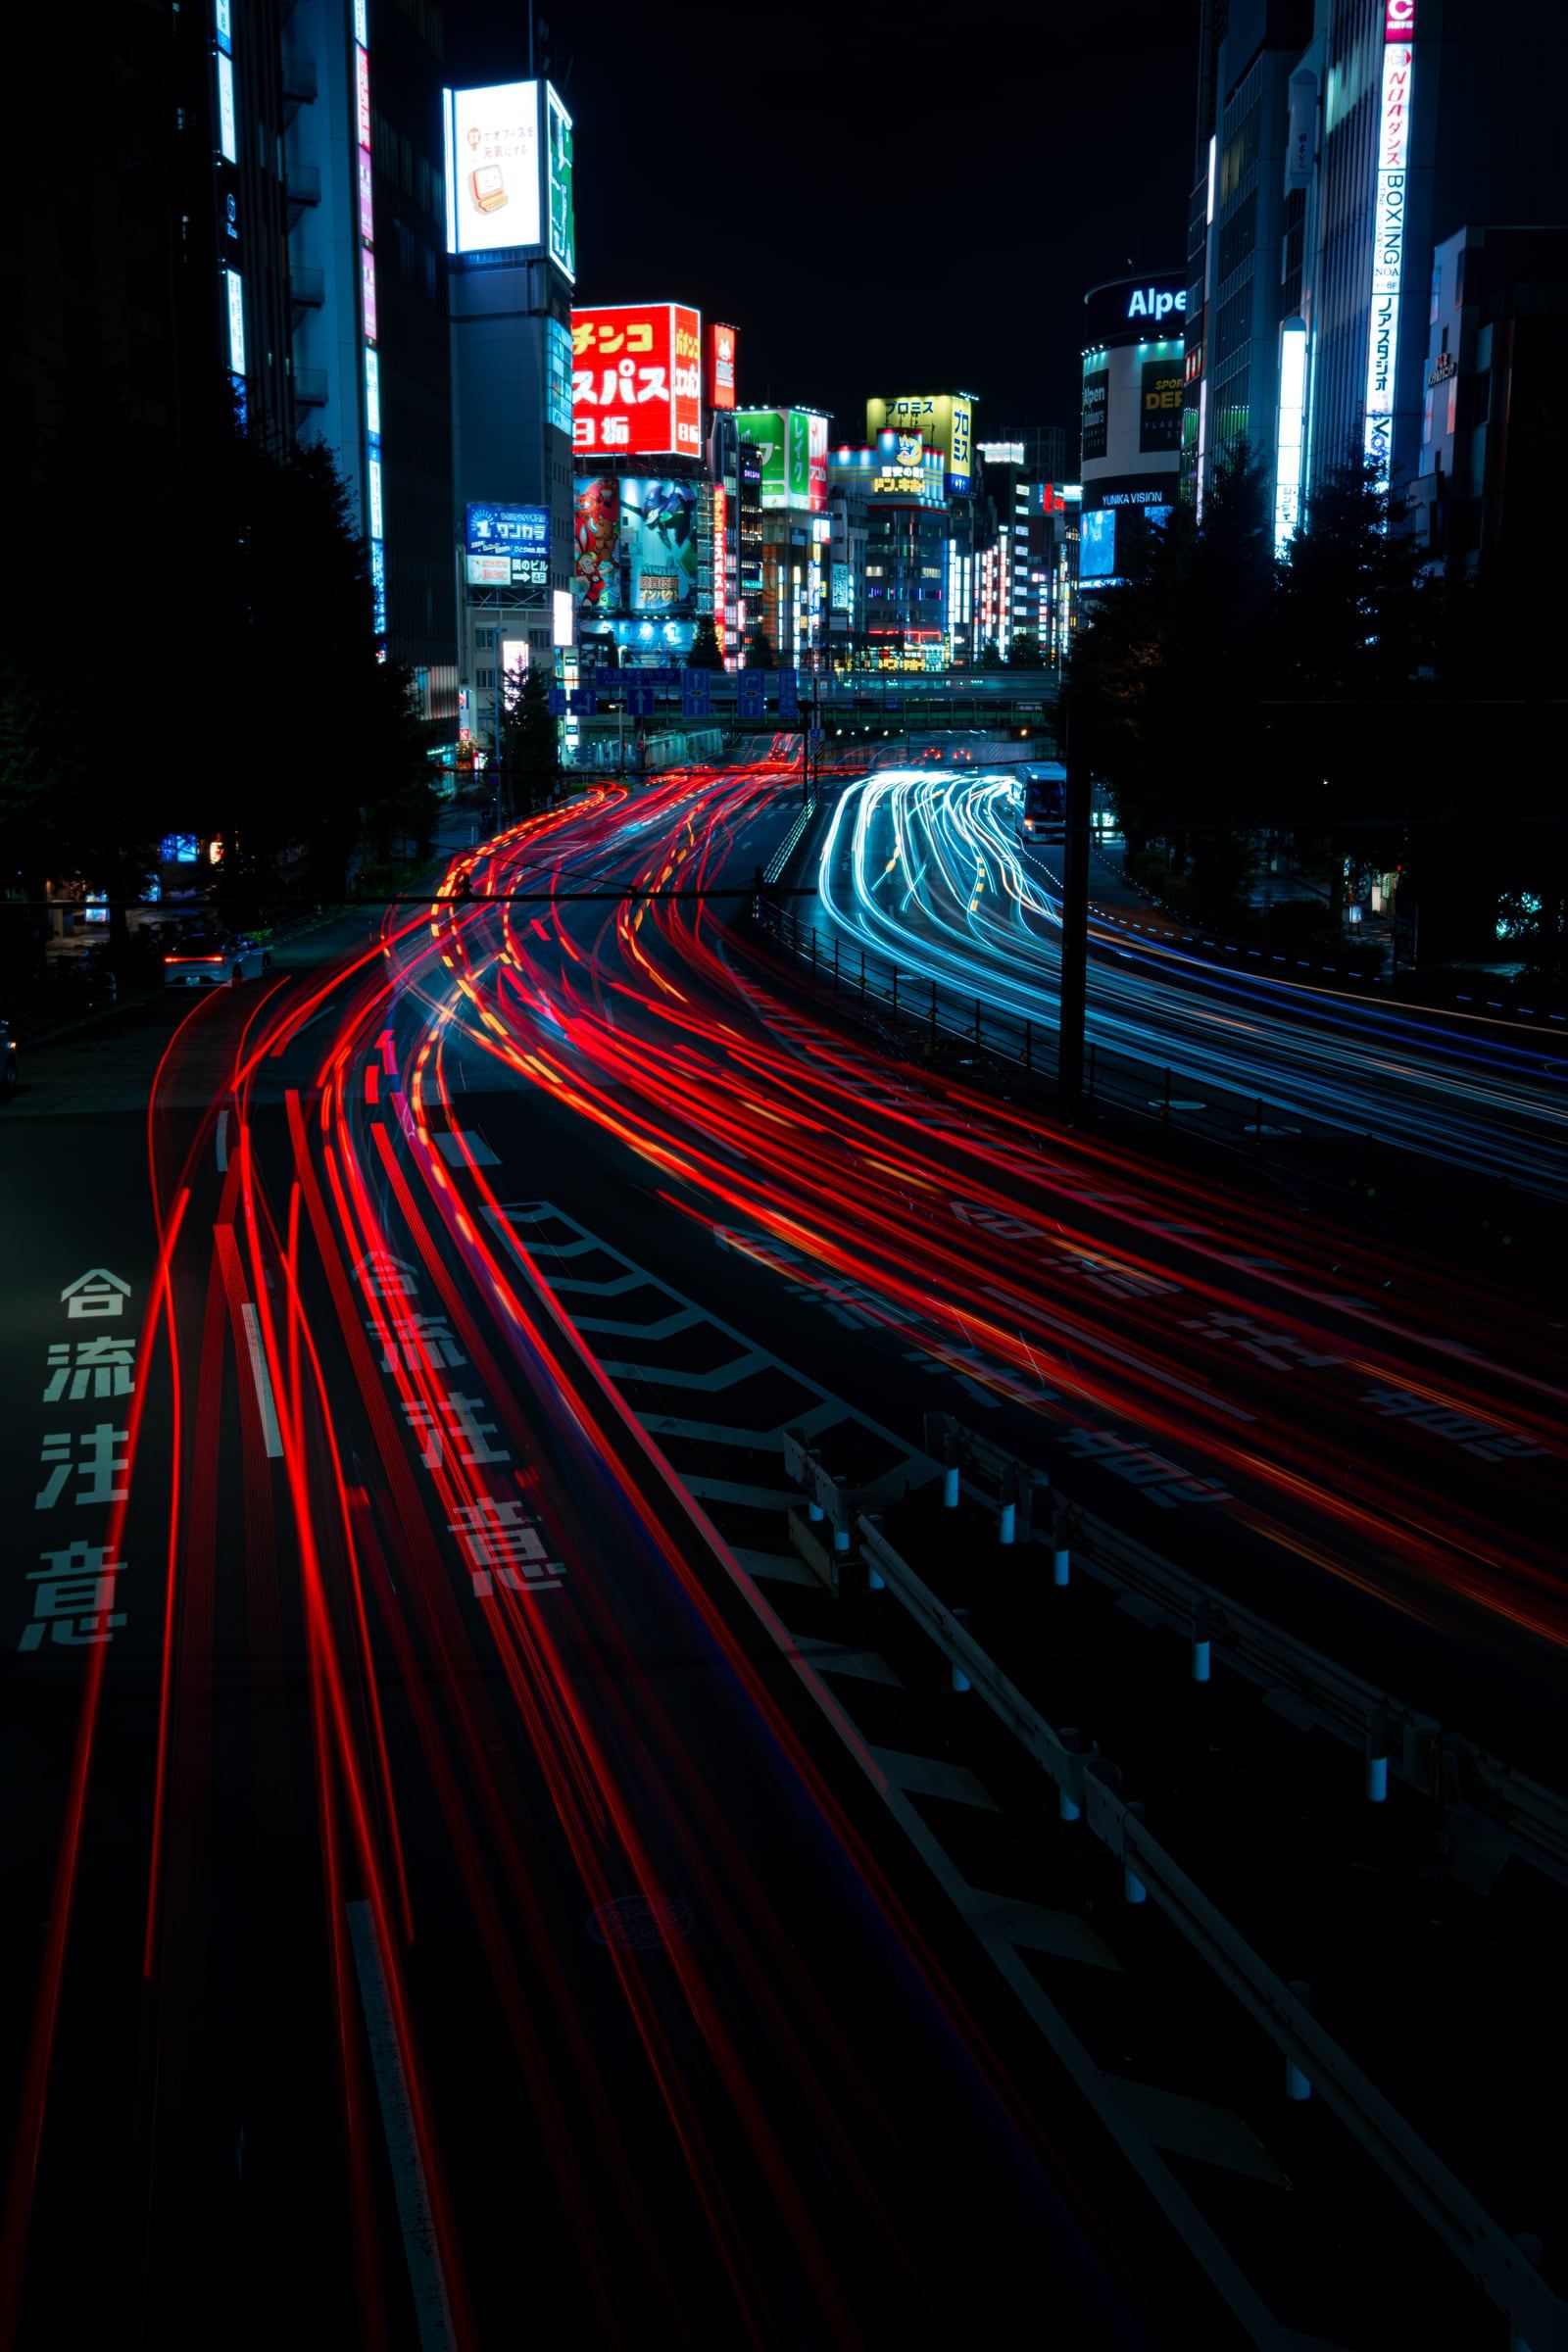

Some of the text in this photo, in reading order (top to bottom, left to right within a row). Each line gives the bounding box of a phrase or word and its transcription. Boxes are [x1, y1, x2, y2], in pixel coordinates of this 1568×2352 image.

[1383, 173, 1404, 266] BOXING
[1375, 267, 1400, 277] NOA
[1375, 297, 1392, 392] ノアスタジオ
[885, 401, 934, 416] プロミス
[795, 417, 804, 482] レイク
[1102, 491, 1163, 507] YUNIKA VISION
[17, 1267, 137, 1652] 合流注意
